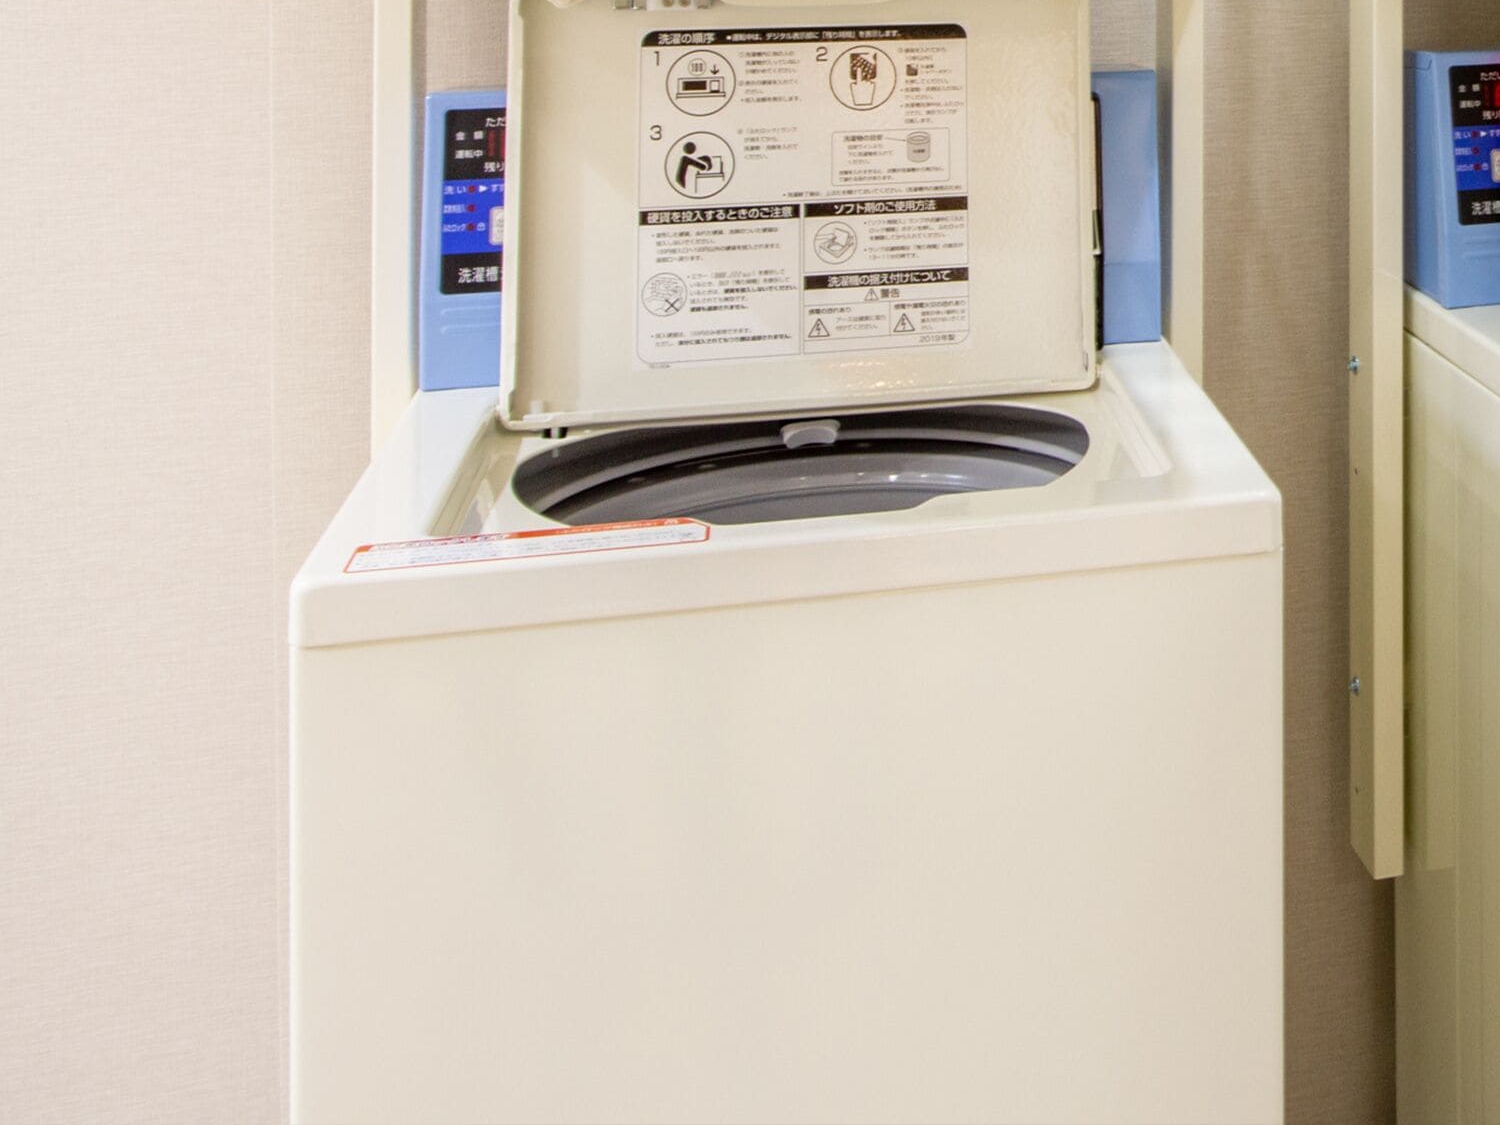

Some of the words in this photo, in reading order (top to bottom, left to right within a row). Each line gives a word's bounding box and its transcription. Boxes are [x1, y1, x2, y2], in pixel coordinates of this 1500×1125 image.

[658, 33, 717, 45] 洗濯の順序
[654, 51, 660, 66] 1
[816, 46, 828, 62] 2
[650, 124, 662, 141] 3
[834, 200, 936, 214] ソフト剤のご使用方法
[647, 207, 792, 224] 硬貨を投入するときのご注意
[828, 270, 951, 287] 洗濯機の据え付けについて
[881, 289, 899, 298] 警告
